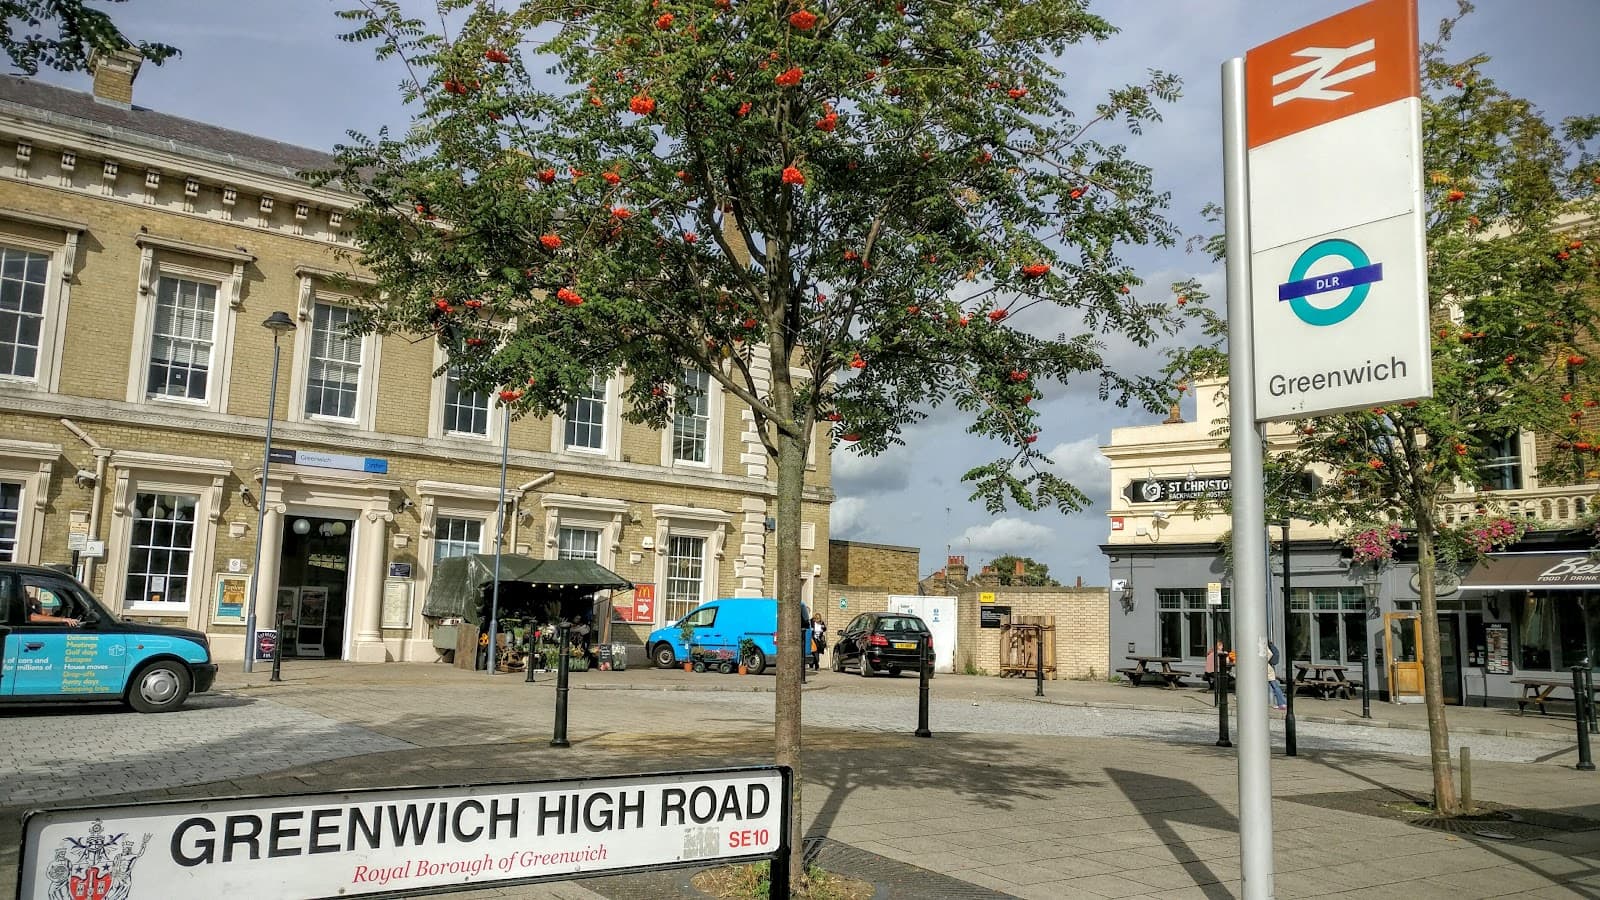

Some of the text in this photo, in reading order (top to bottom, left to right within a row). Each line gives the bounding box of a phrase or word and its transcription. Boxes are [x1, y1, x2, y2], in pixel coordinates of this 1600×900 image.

[1316, 277, 1340, 290] DLR
[1269, 356, 1407, 397] Greenwich
[1168, 482, 1182, 492] ST
[170, 783, 770, 867] GREENWICH HIGH ROAD
[728, 829, 769, 848] SE10
[352, 844, 608, 888] Royal Borough of Greenwich
